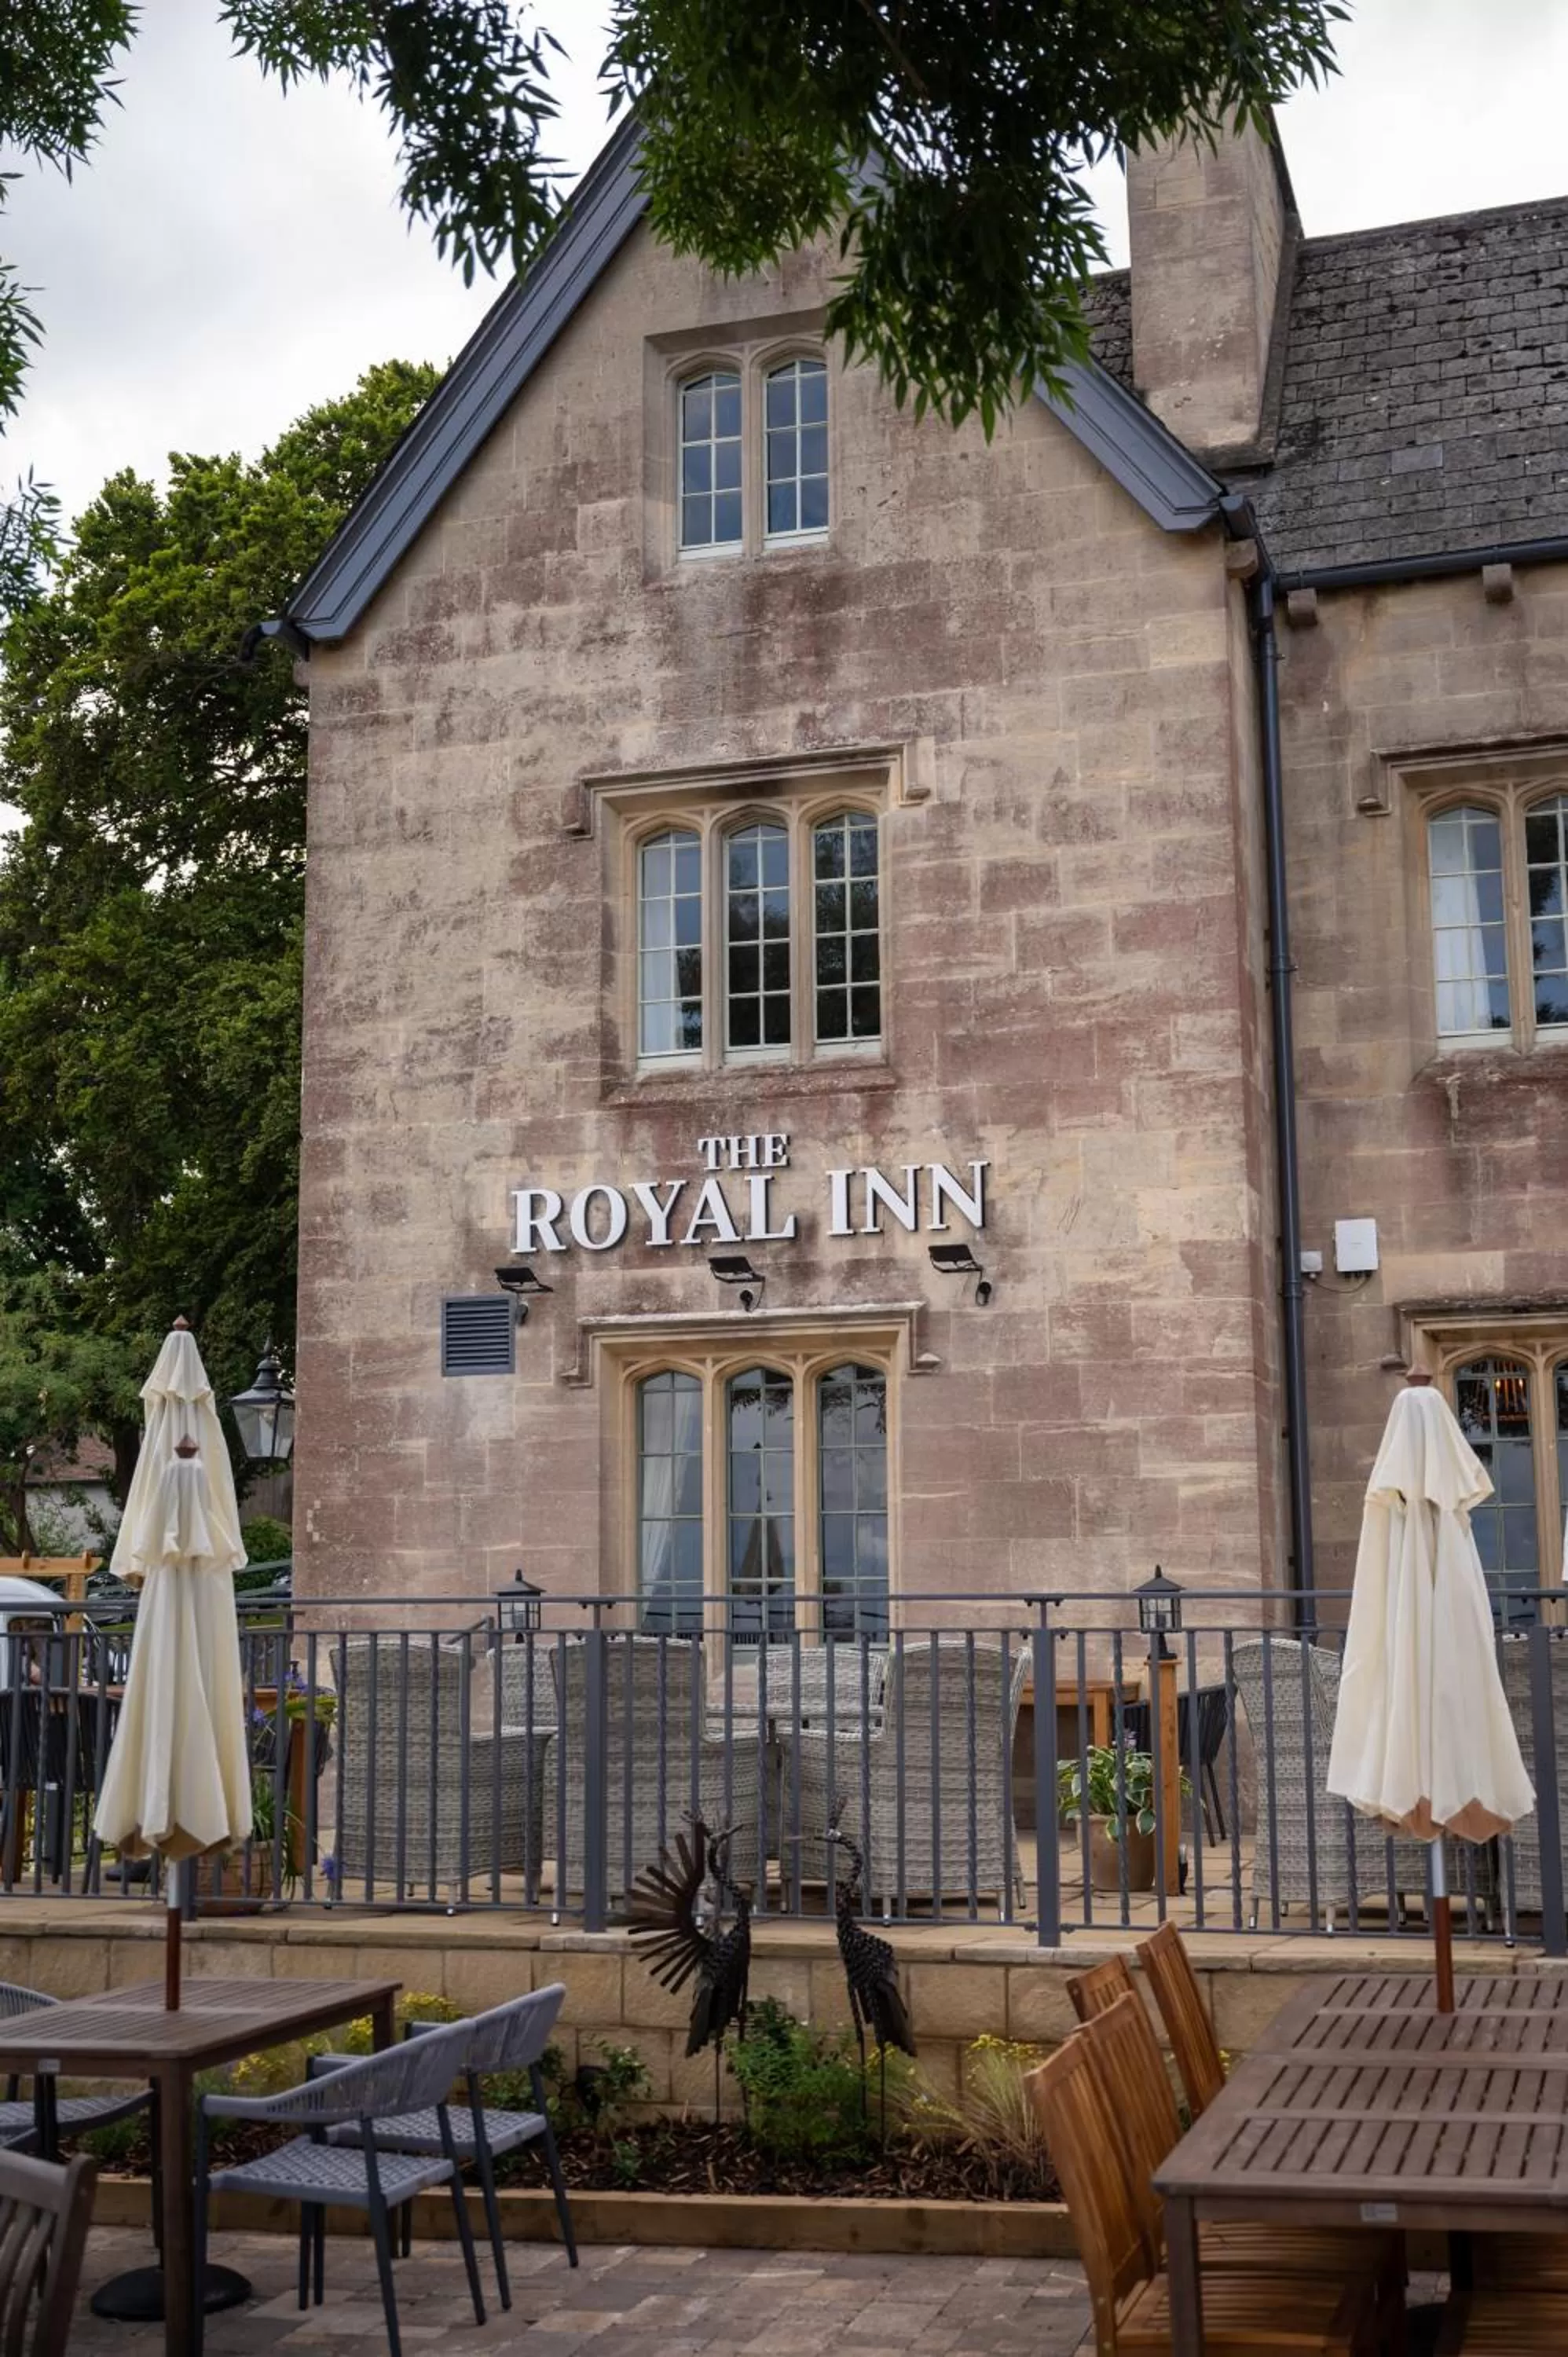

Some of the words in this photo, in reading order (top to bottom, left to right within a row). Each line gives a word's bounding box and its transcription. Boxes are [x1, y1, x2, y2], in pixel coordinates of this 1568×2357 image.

[698, 1134, 789, 1171] THE
[511, 1175, 796, 1253] ROYAL
[826, 1161, 991, 1236] INN
